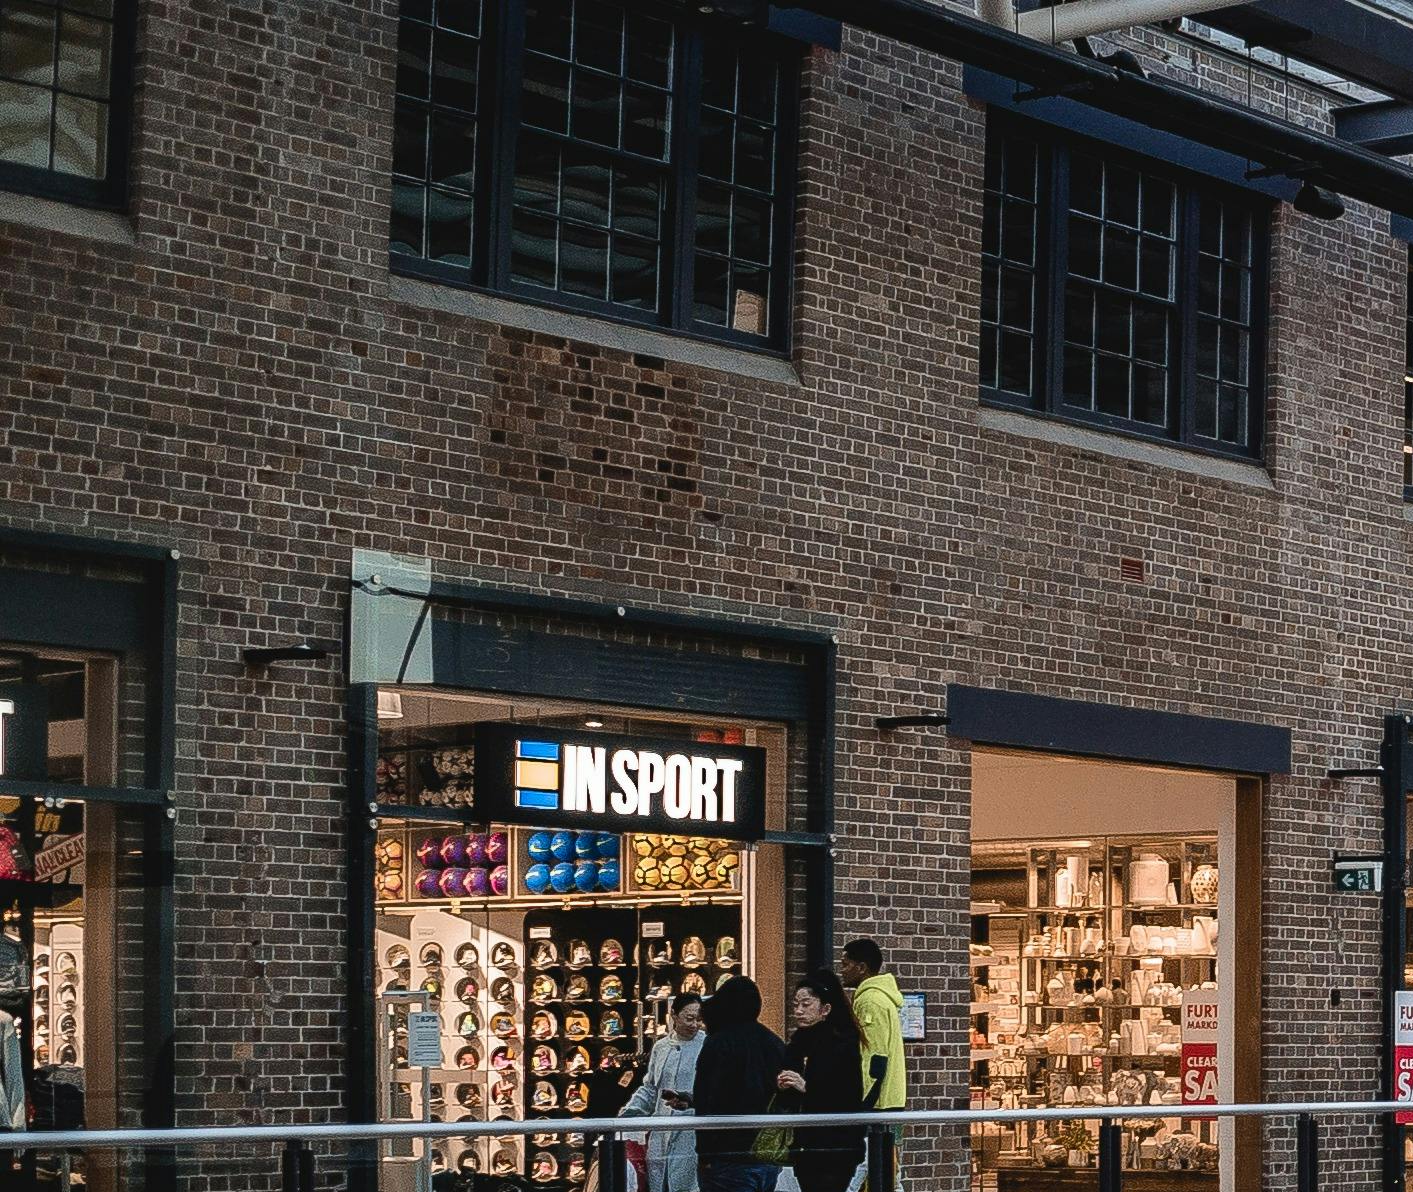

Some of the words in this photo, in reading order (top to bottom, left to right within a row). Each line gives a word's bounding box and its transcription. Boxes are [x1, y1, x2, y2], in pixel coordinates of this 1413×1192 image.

[562, 743, 607, 814] IN
[610, 749, 744, 823] SPORT
[1187, 1004, 1218, 1018] FURT
[1187, 1020, 1218, 1030] MARKD
[1187, 1056, 1218, 1068] CLEAR
[1185, 1069, 1218, 1101] SA
